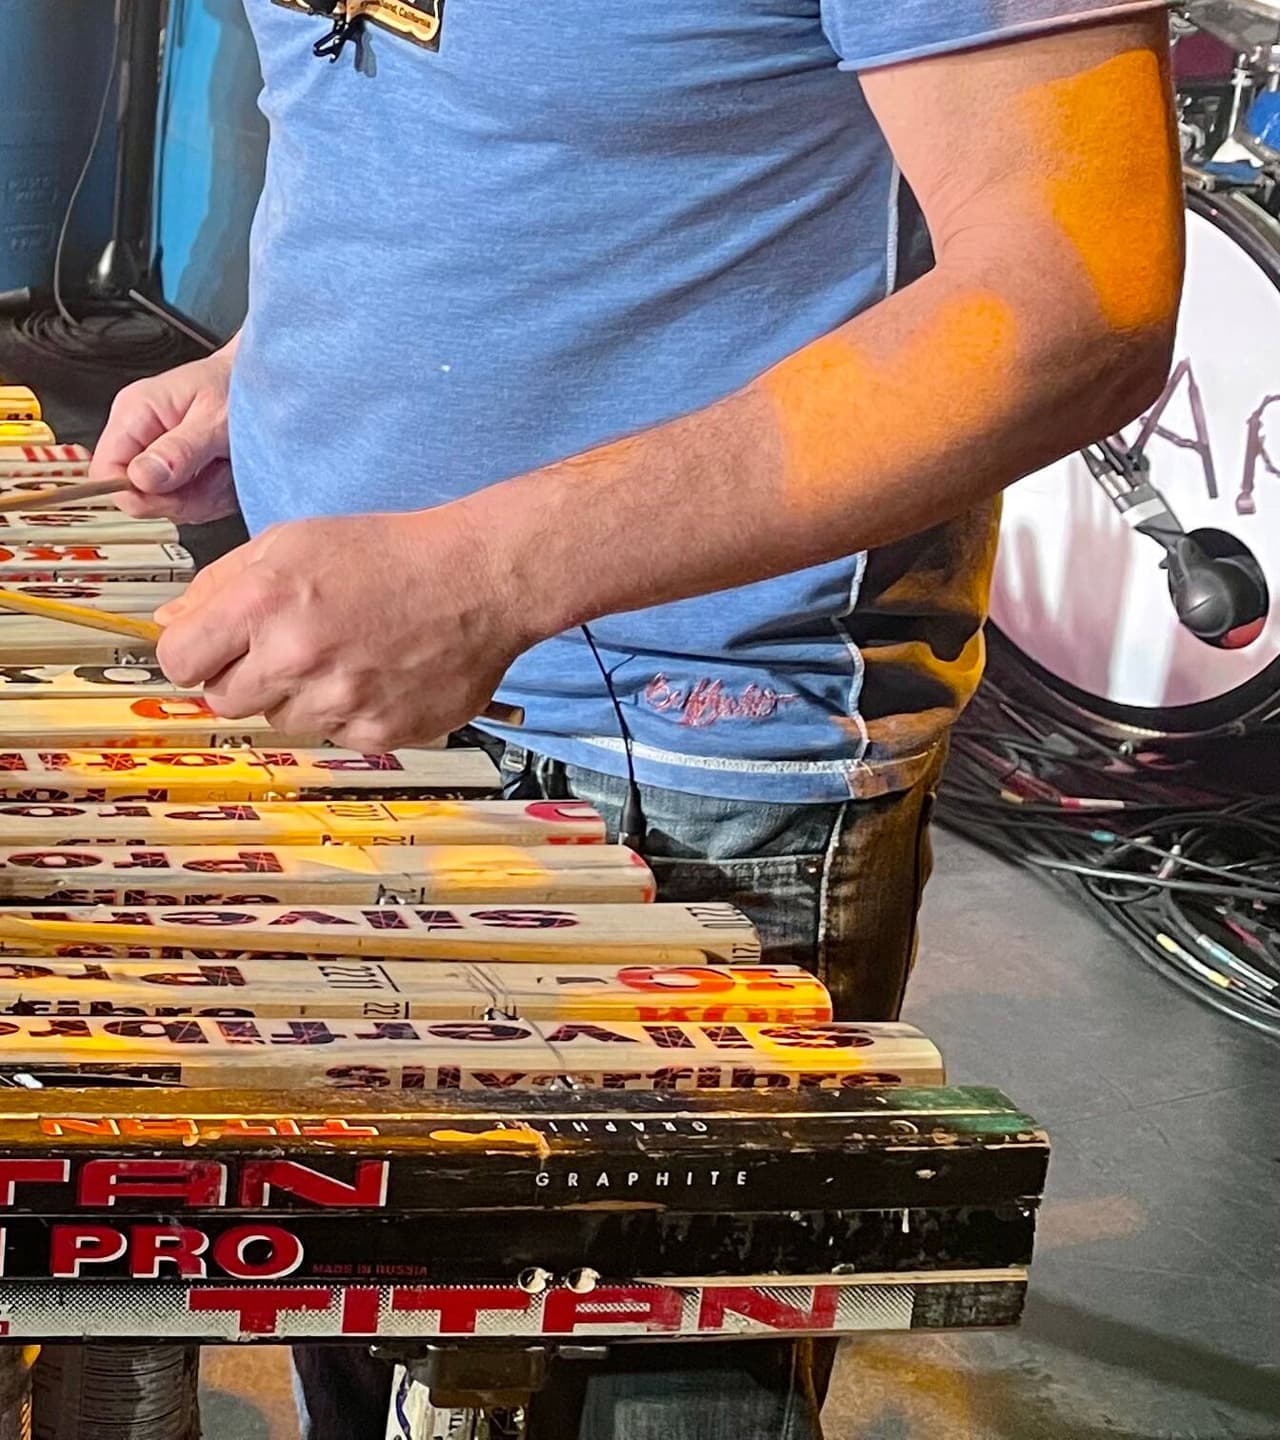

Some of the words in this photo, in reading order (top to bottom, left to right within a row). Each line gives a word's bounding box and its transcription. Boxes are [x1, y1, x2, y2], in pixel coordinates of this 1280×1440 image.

[534, 1170, 749, 1188] GRAPHITE
[49, 1223, 305, 1279] PRO
[188, 1285, 839, 1334] TITAN
